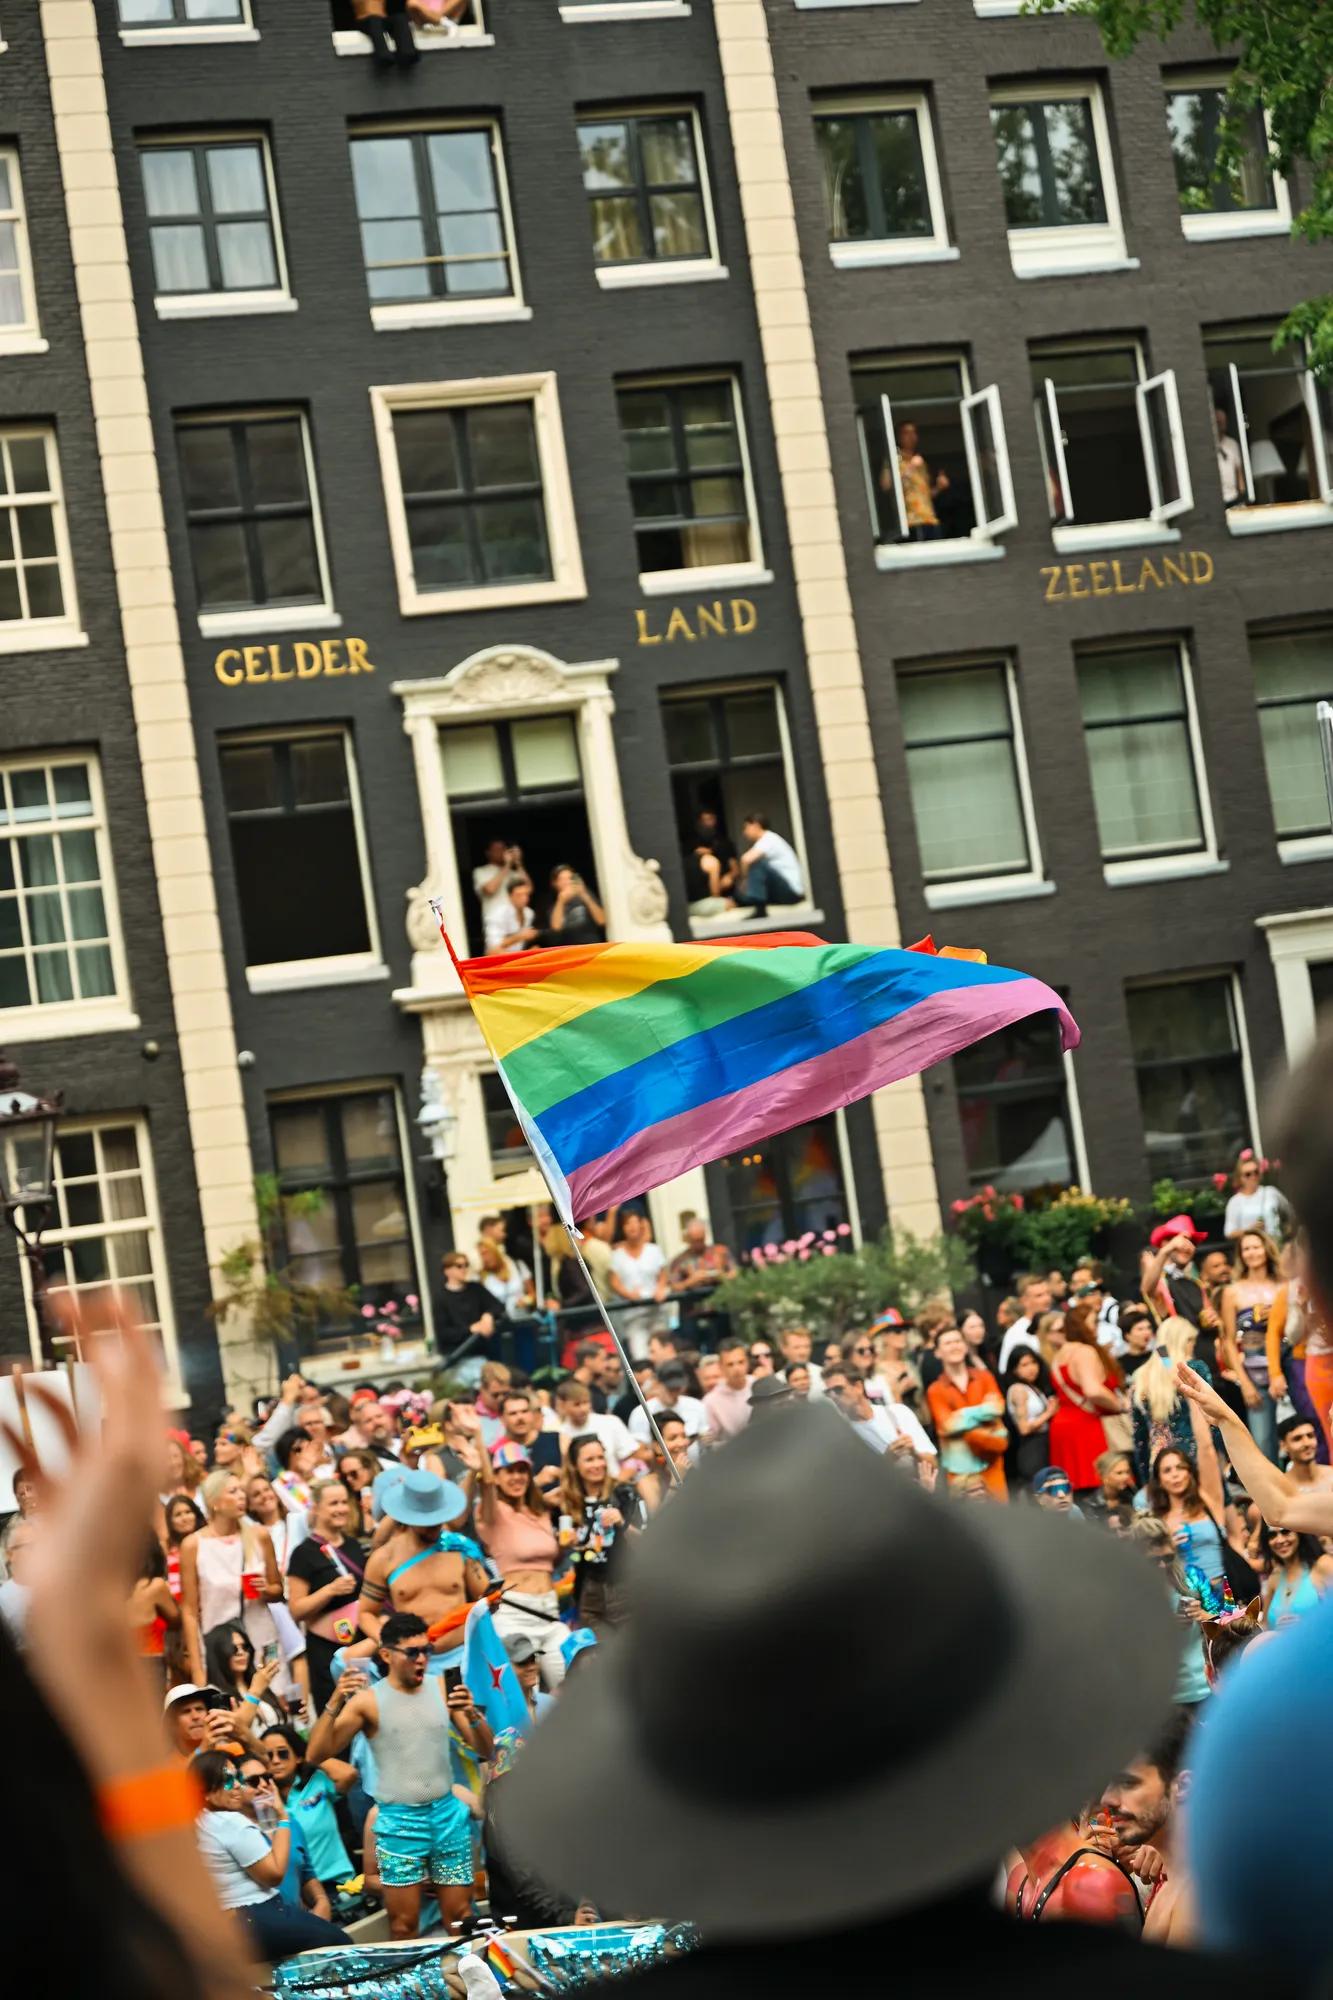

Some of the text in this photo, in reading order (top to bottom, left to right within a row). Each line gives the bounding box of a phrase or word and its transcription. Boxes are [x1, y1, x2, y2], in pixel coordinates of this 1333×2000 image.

[1040, 551, 1214, 602] ZEELAND
[214, 599, 757, 687] GELDER LAND
